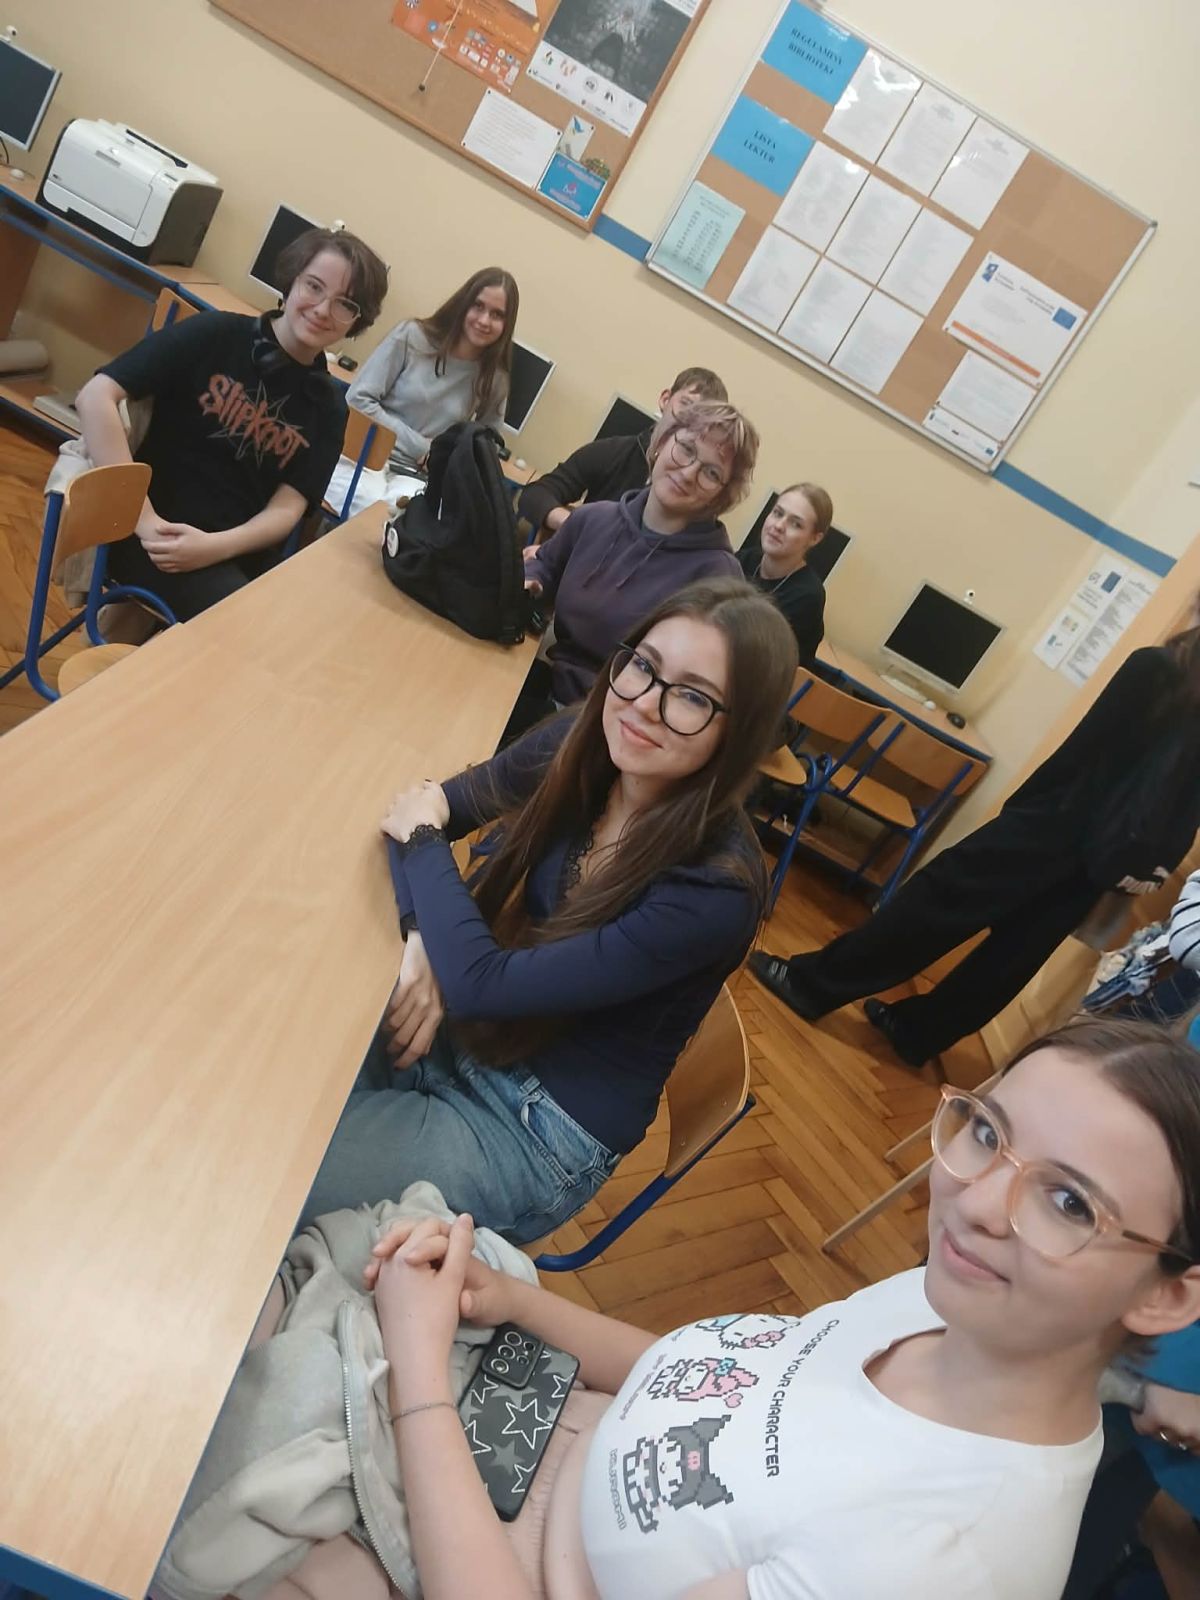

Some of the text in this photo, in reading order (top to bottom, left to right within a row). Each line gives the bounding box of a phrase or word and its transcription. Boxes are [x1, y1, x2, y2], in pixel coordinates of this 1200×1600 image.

[743, 139, 775, 163] LEKTUR
[753, 130, 777, 149] LISTA
[764, 1318, 840, 1478] CHOOSE YOUR CHARACTER
